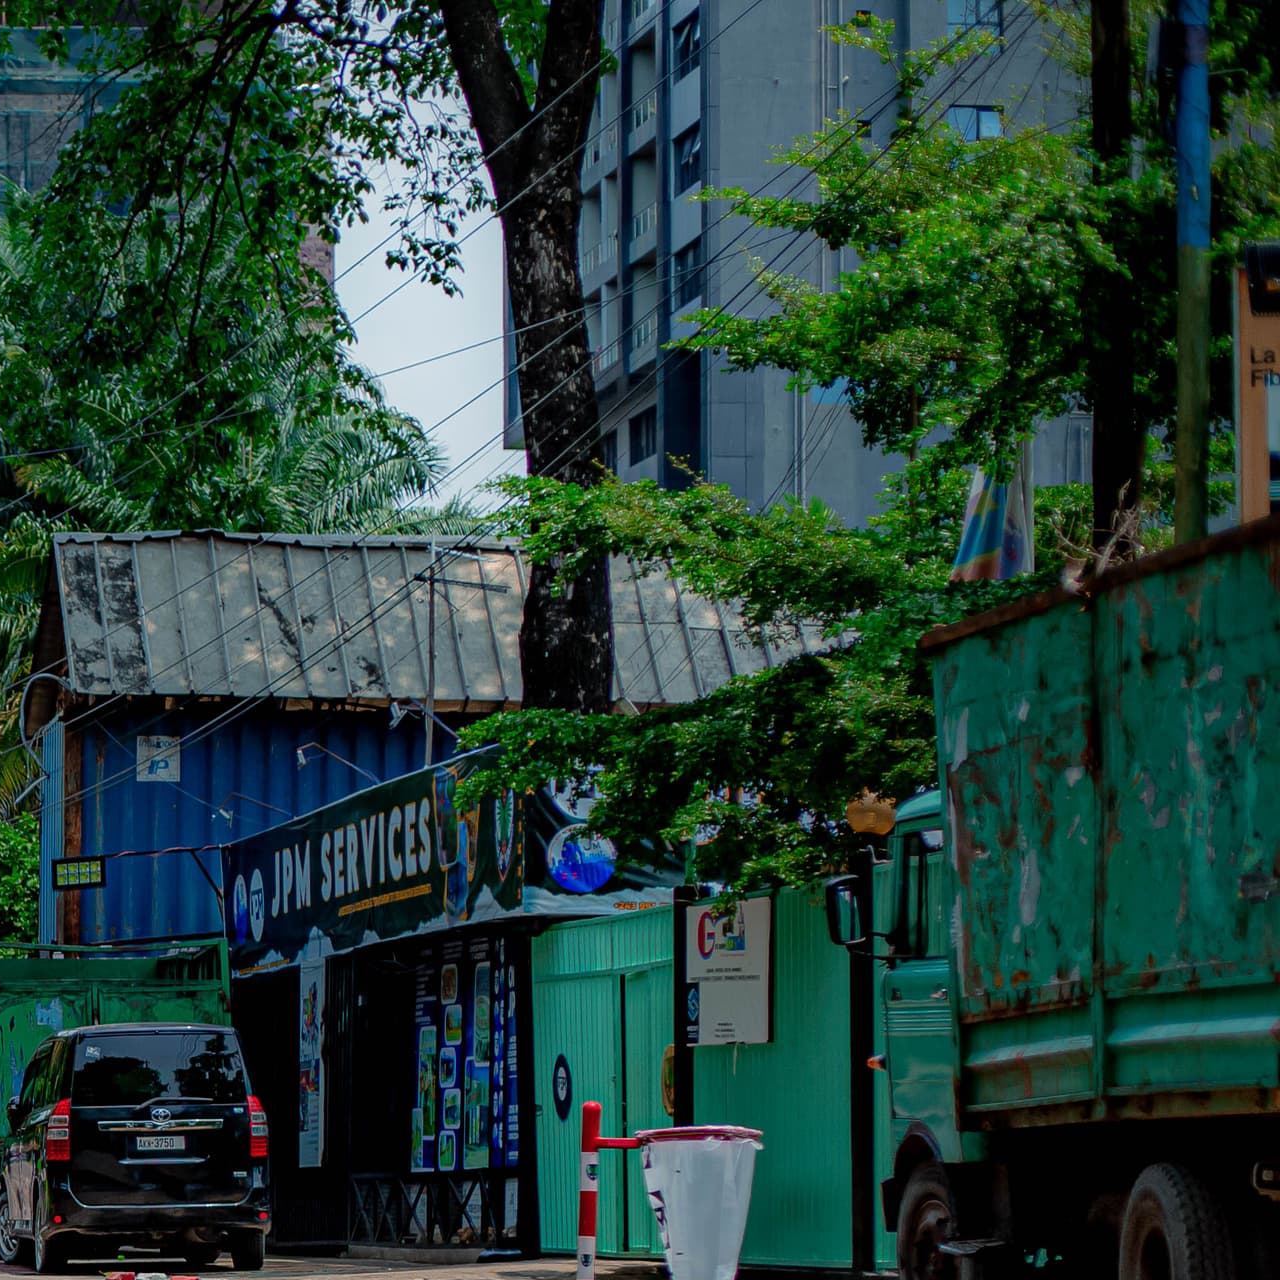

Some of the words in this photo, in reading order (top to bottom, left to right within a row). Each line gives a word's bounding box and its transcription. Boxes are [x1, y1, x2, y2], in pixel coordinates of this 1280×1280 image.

[1250, 344, 1276, 364] La
[271, 840, 312, 919] JPM
[320, 797, 432, 903] SERVICES
